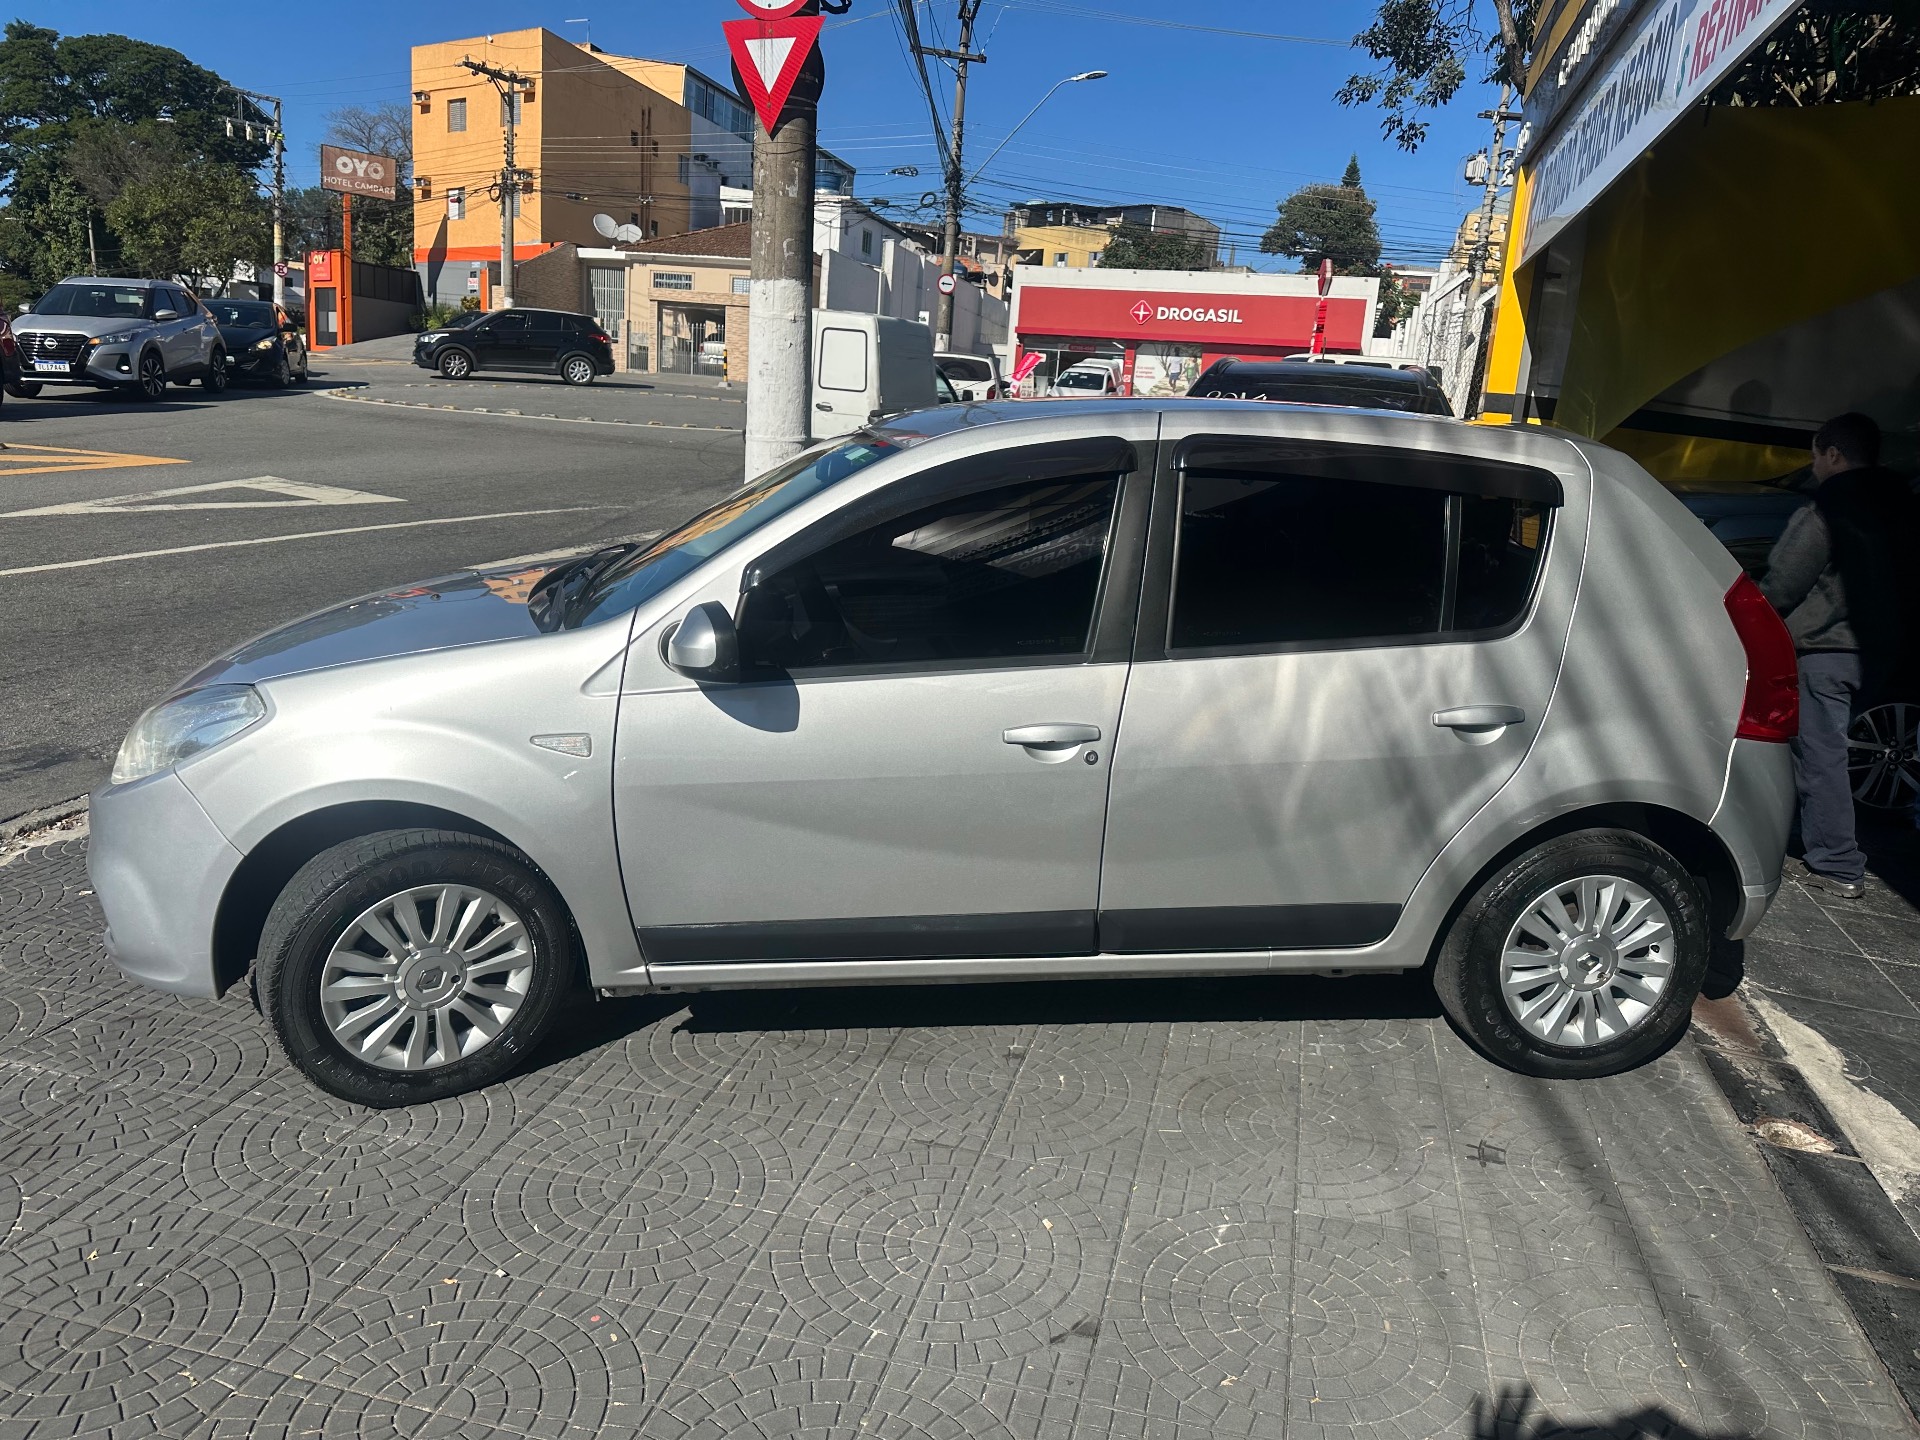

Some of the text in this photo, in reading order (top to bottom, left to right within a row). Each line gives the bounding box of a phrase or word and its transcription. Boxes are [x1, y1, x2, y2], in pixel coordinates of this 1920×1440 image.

[1571, 79, 1618, 193] PERDER
[1610, 2, 1678, 152] NEGÓCIO
[336, 156, 384, 180] OYO
[324, 176, 353, 188] HOTEL
[1156, 306, 1243, 323] DROGASIL
